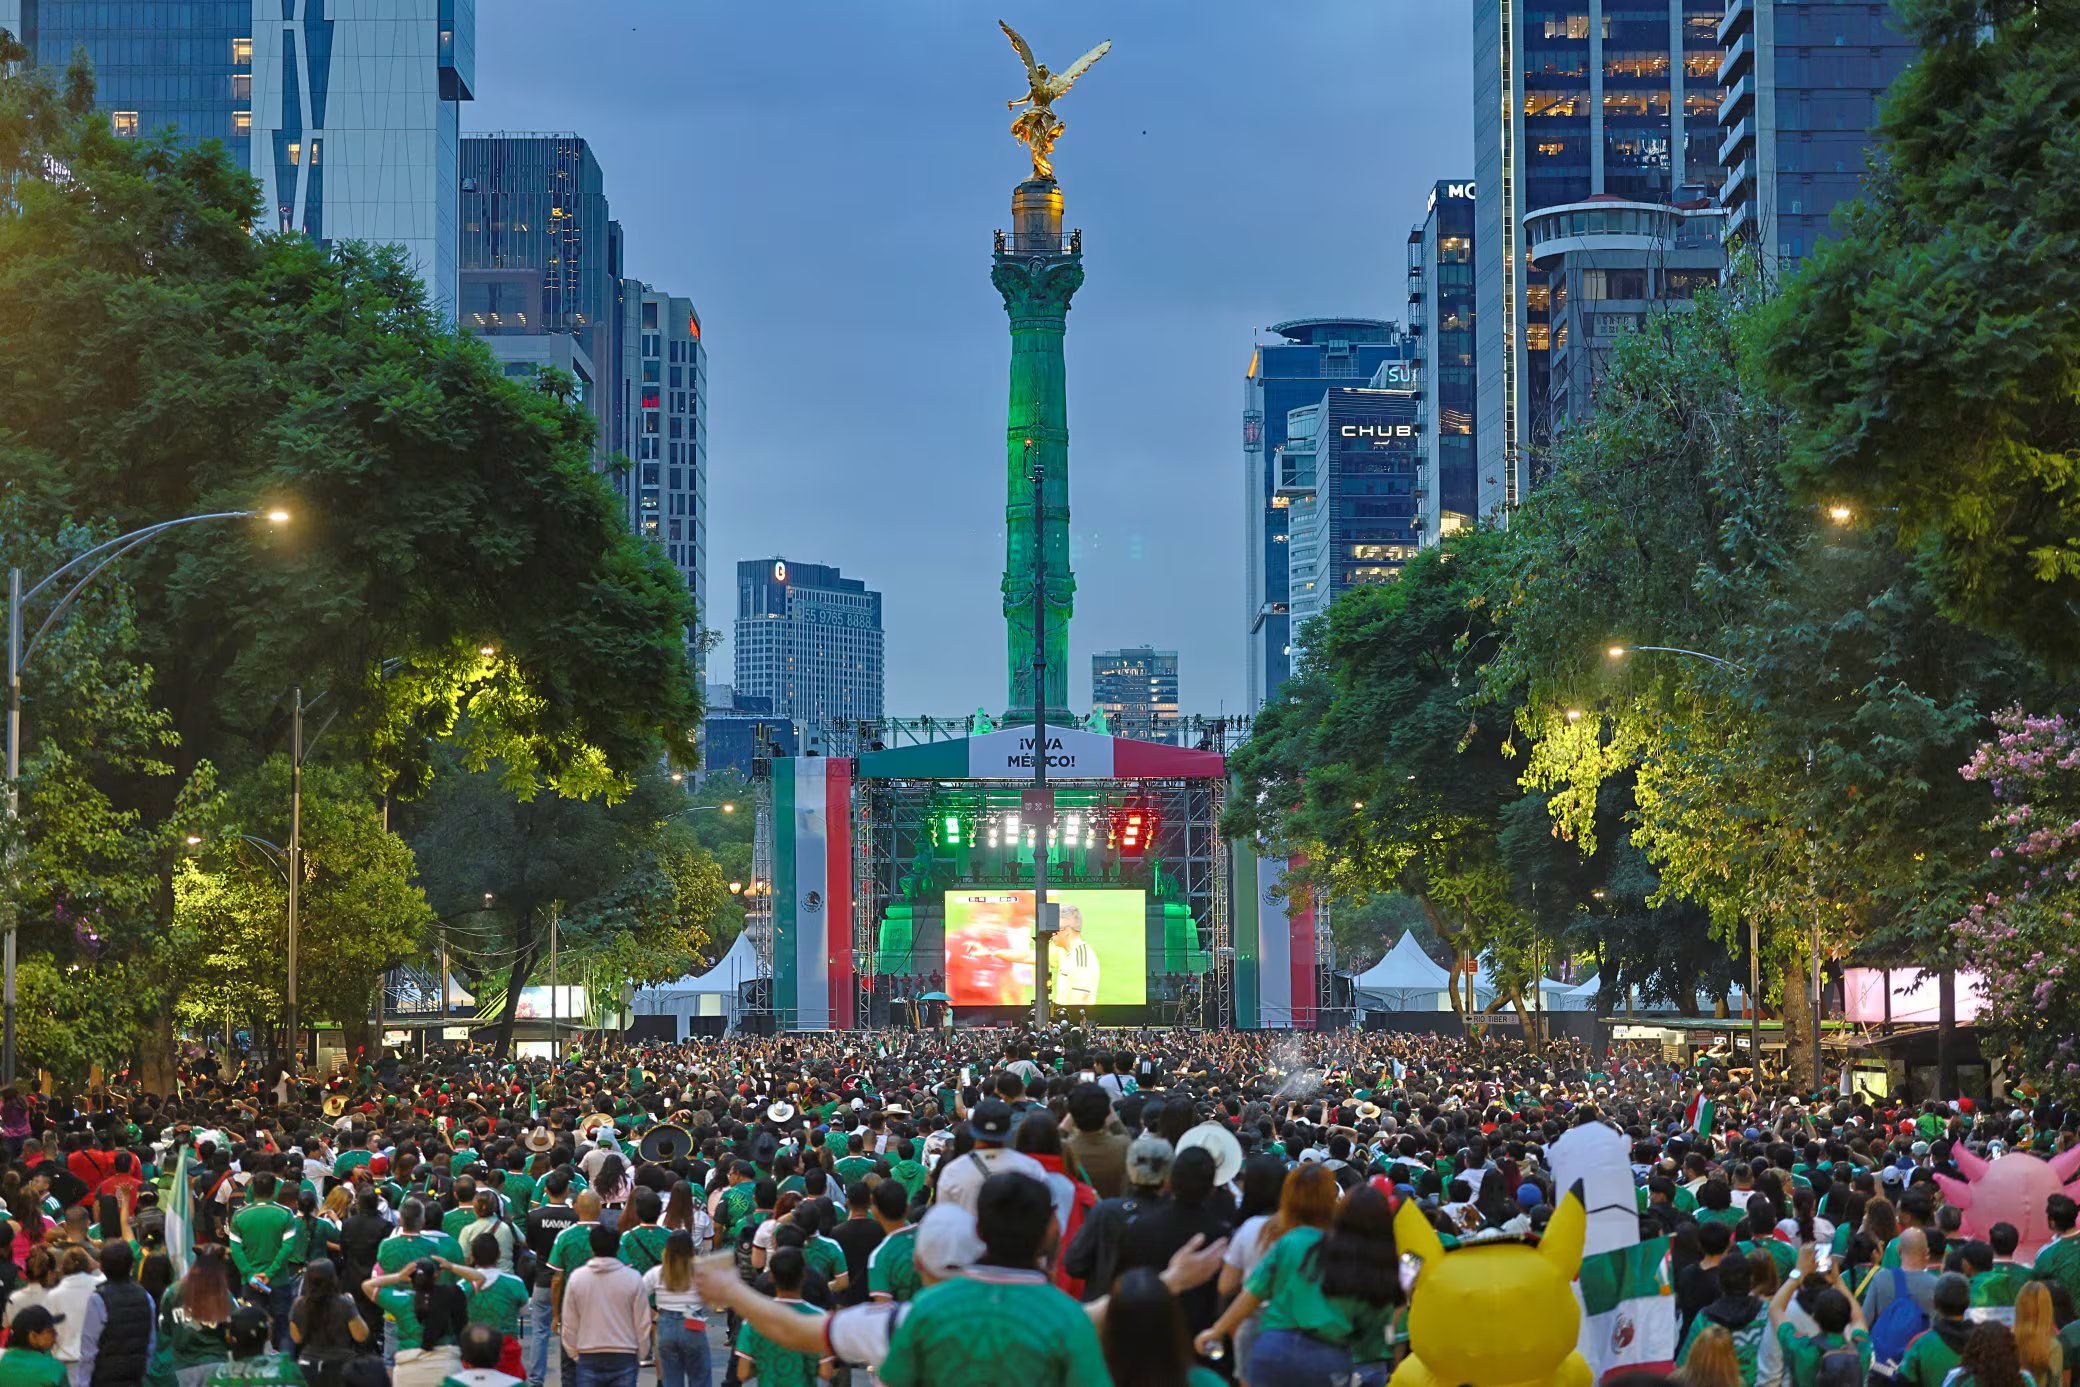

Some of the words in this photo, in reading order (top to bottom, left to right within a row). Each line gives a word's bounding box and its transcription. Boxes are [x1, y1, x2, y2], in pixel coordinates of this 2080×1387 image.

[1341, 425, 1418, 437] CHUB
[805, 608, 817, 622] 55
[819, 611, 844, 626] 9765
[847, 613, 872, 629] 8888
[1488, 1015, 1508, 1023] TIBER
[1489, 1086, 1497, 1097] 3
[541, 1219, 572, 1229] KAVAK
